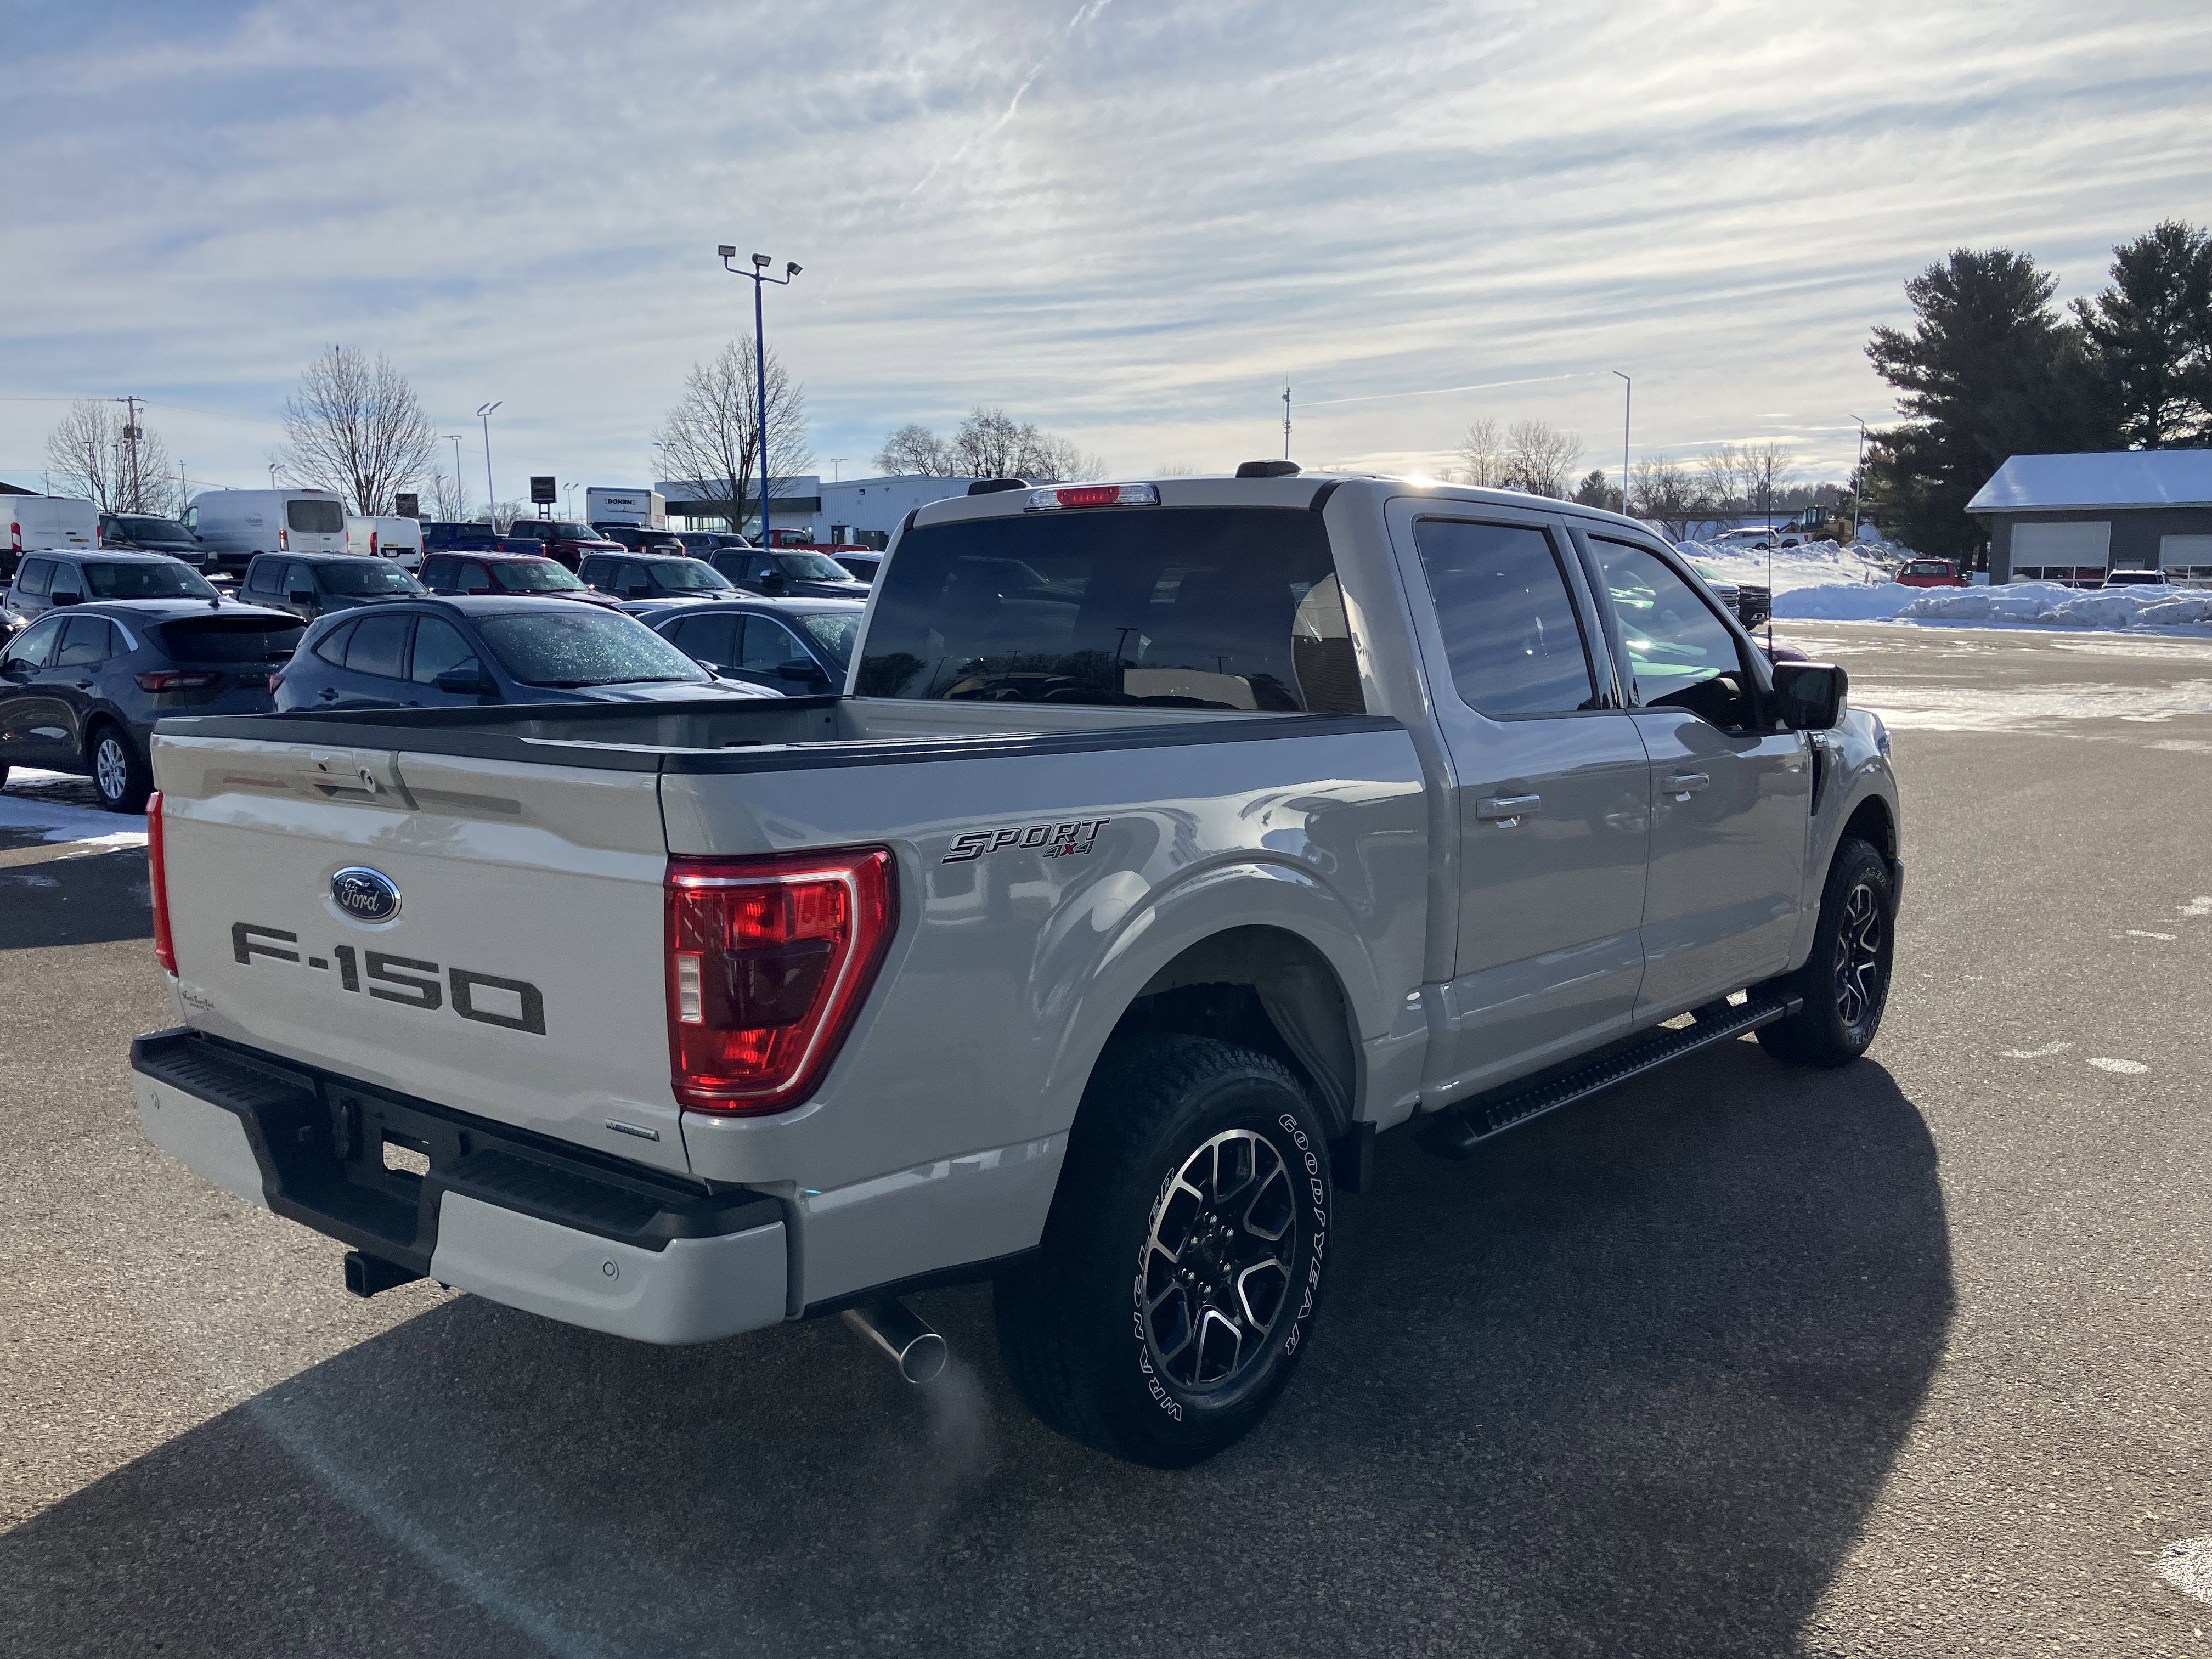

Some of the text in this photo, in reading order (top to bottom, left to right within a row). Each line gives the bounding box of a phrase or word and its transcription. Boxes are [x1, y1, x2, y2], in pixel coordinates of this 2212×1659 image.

[941, 817, 1110, 865] SPORT
[341, 878, 379, 911] Ford
[232, 922, 546, 1036] F-150
[1279, 1114, 1325, 1355] GOODYEAR
